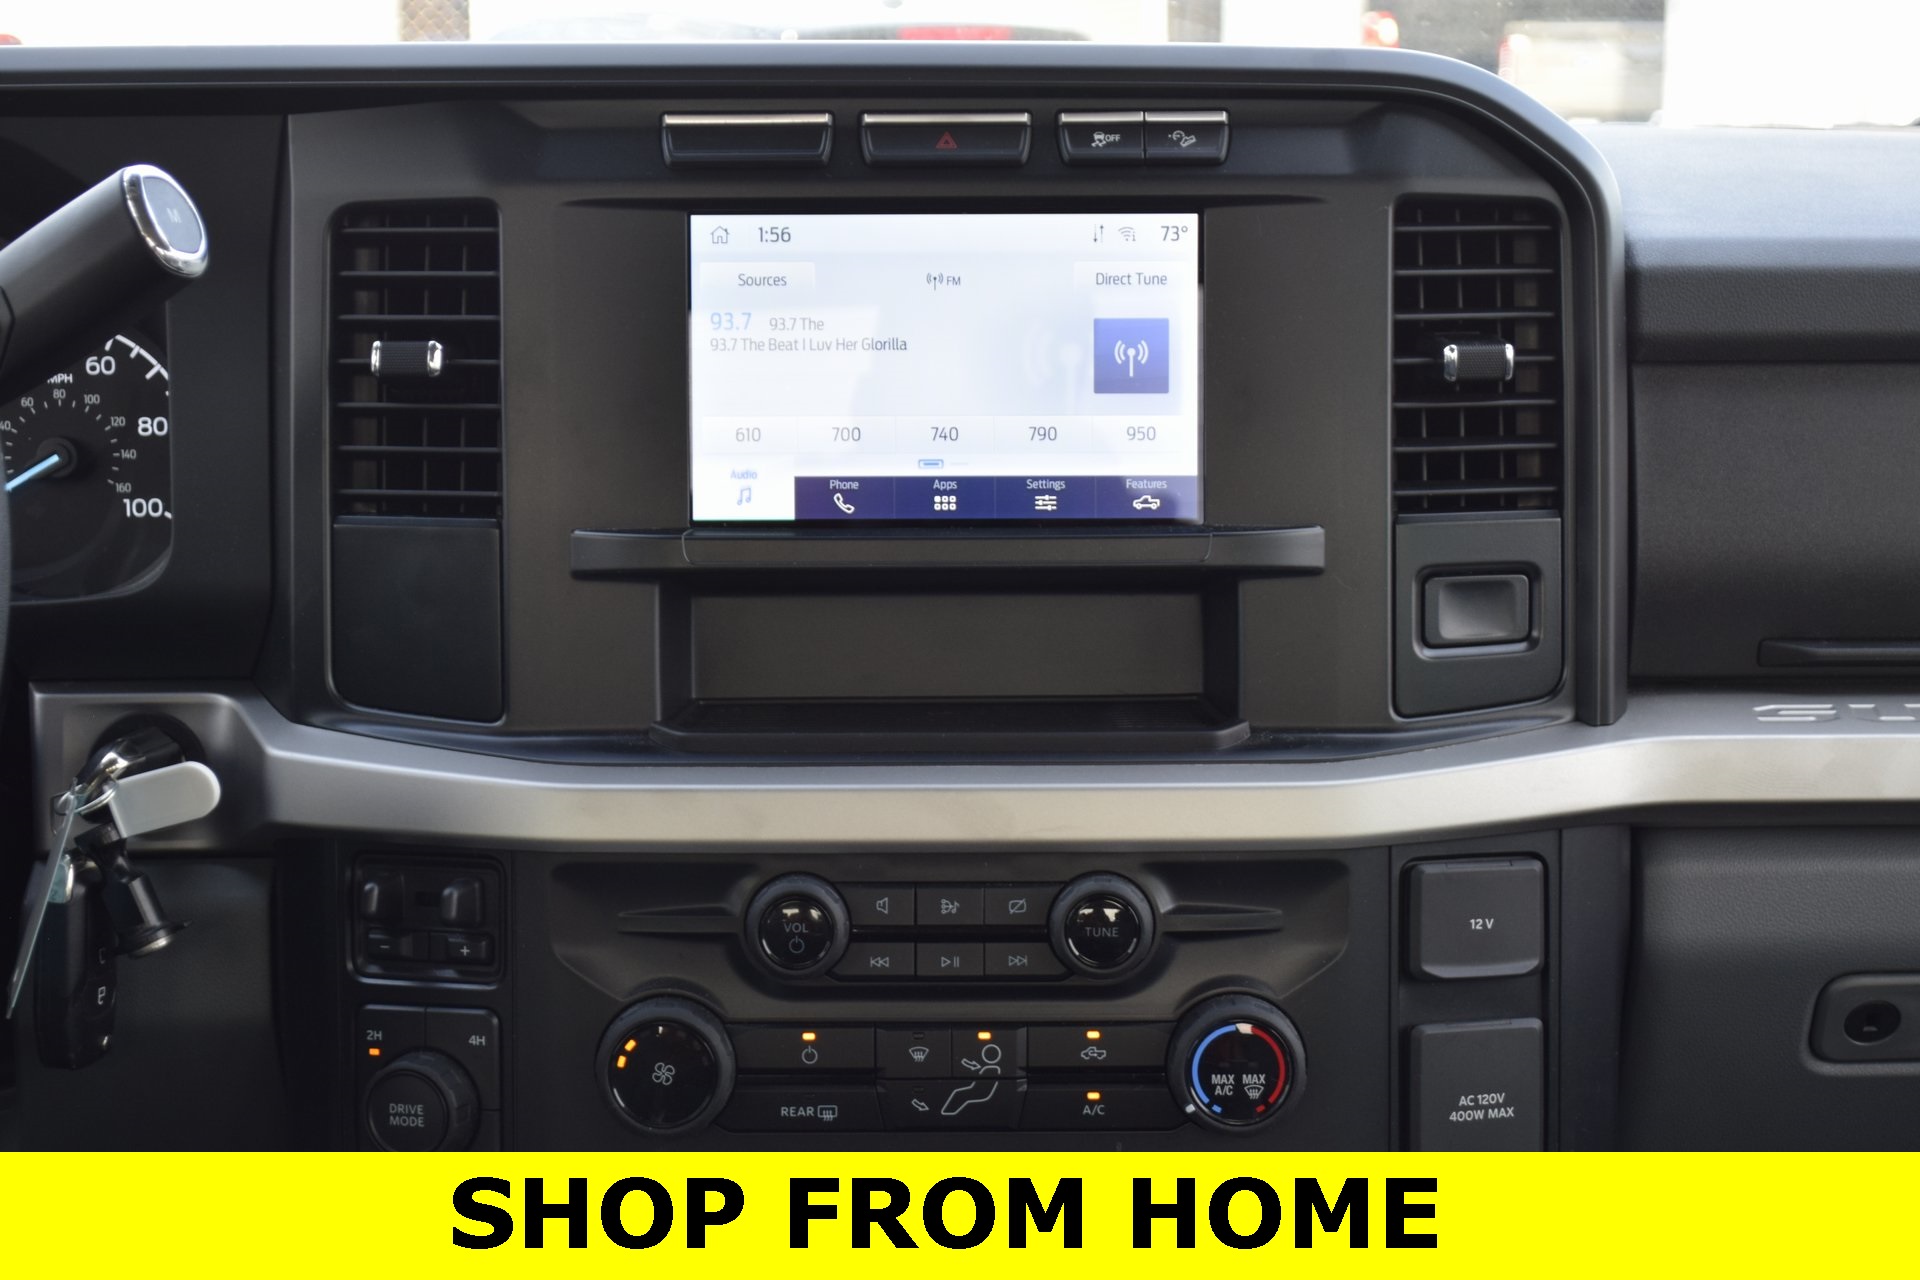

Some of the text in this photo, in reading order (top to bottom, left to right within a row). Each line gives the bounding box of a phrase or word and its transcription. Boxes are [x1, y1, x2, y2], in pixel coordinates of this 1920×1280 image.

[1104, 133, 1121, 144] OFF
[758, 226, 792, 243] 1:56
[1160, 225, 1189, 242] 73°
[737, 273, 788, 287] Sources
[946, 275, 961, 286] FM
[1095, 272, 1168, 286] Direct Tune
[710, 311, 753, 331] 93.7
[768, 317, 825, 331] 93.7 The
[709, 337, 738, 352] 93.7
[740, 337, 766, 352] The
[768, 337, 799, 352] Beat
[809, 337, 833, 352] Luv
[835, 337, 859, 351] Her
[861, 337, 908, 351] Glorilla
[85, 355, 116, 376] 60
[52, 388, 67, 401] 80
[83, 393, 101, 405] 100
[20, 396, 34, 408] 60
[110, 416, 126, 427] 120
[137, 416, 169, 437] 80
[735, 427, 762, 443] 610
[832, 426, 862, 442] 700
[931, 426, 959, 442] 740
[1028, 426, 1058, 442] 790
[1126, 425, 1157, 441] 950
[120, 448, 137, 460] 140
[730, 469, 758, 480] Audio
[115, 482, 132, 493] 160
[829, 479, 860, 490] Phone
[932, 478, 958, 491] Apps
[1026, 478, 1066, 491] Settings
[1126, 479, 1168, 490] Features
[122, 497, 164, 518] 100
[783, 922, 809, 933] VOL
[1469, 918, 1494, 930] 12 V
[1084, 926, 1119, 938] TUNE
[366, 1029, 383, 1041] 2H
[468, 1034, 486, 1046] 4H
[1211, 1073, 1235, 1087] MAX
[1242, 1073, 1266, 1085] MAX
[1214, 1084, 1234, 1096] A/C
[1458, 1092, 1506, 1107] AC 120V
[389, 1103, 424, 1115] DRIVE
[780, 1106, 815, 1117] REAR
[1082, 1104, 1105, 1116] A/C
[1449, 1106, 1515, 1122] 400W MAX
[389, 1115, 425, 1128] MODE
